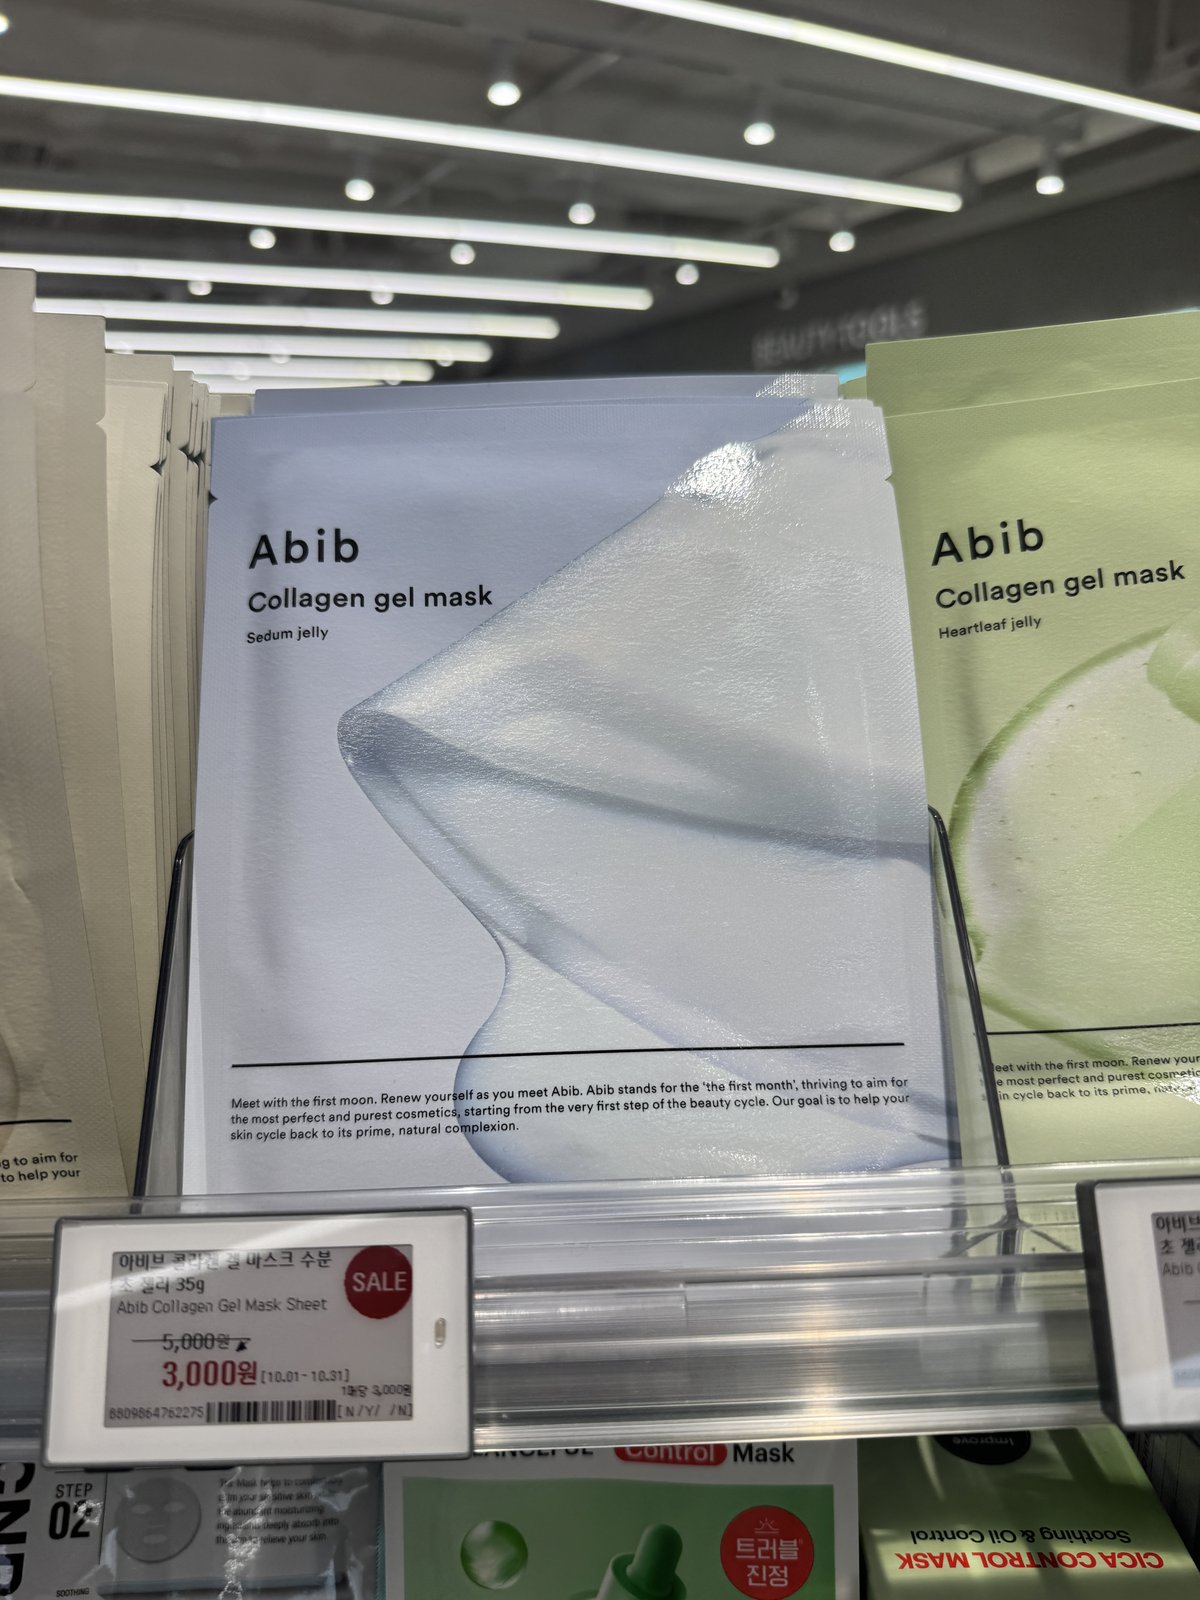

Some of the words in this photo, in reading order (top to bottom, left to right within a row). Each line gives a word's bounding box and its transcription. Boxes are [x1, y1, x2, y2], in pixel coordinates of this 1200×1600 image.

[248, 528, 359, 569] Abib
[931, 518, 1044, 567] Abib
[935, 577, 1055, 609] Collagen
[1063, 567, 1104, 597] gel
[1113, 560, 1186, 587] mask
[248, 587, 365, 613] Collagen
[374, 586, 414, 613] gel
[424, 584, 493, 607] mask
[246, 629, 293, 644] Sedum
[296, 626, 329, 641] jelly
[938, 617, 1008, 639] Heartleaf
[1011, 615, 1042, 632] jelly
[992, 1063, 1014, 1073] eet
[1017, 1061, 1042, 1072] with
[1044, 1060, 1064, 1071] the
[1066, 1059, 1089, 1070] first
[1092, 1059, 1128, 1069] moon.
[1132, 1055, 1171, 1066] Renew
[1006, 1076, 1036, 1087] most
[1038, 1074, 1081, 1088] perfect
[1083, 1073, 1104, 1084] and
[1107, 1071, 1145, 1083] purest
[231, 1098, 260, 1109] Meet
[263, 1096, 288, 1108] with
[291, 1096, 310, 1108] the
[313, 1095, 337, 1107] first
[340, 1096, 377, 1107] moon.
[381, 1092, 421, 1105] Renew
[425, 1089, 474, 1105] yourself
[477, 1091, 490, 1101] as
[493, 1090, 515, 1103] you
[518, 1087, 548, 1099] meet
[551, 1085, 583, 1097] Abib.
[587, 1084, 615, 1097] Abib
[618, 1083, 657, 1096] stands
[660, 1081, 677, 1094] for
[680, 1082, 700, 1093] the
[729, 1080, 752, 1092] first
[802, 1078, 848, 1092] thriving
[851, 1079, 863, 1089] to
[866, 1077, 888, 1089] aim
[891, 1076, 908, 1088] for
[1013, 1089, 1044, 1101] cycle
[1047, 1088, 1075, 1099] back
[1079, 1087, 1090, 1097] to
[1094, 1086, 1108, 1097] its
[1112, 1084, 1150, 1097] prime,
[230, 1114, 249, 1125] the
[252, 1114, 279, 1125] most
[282, 1111, 326, 1126] perfect
[329, 1111, 350, 1122] and
[354, 1110, 392, 1123] purest
[396, 1106, 461, 1120] cosmetics,
[464, 1104, 510, 1118] starting
[514, 1103, 542, 1115] from
[545, 1102, 565, 1113] the
[568, 1102, 593, 1115] very
[597, 1100, 620, 1112] first
[623, 1100, 649, 1112] step
[652, 1098, 666, 1110] of
[667, 1098, 687, 1109] the
[690, 1096, 731, 1110] beauty
[734, 1096, 769, 1110] cycle.
[772, 1095, 795, 1107] Our
[798, 1094, 823, 1108] goal
[826, 1094, 835, 1105] is
[839, 1094, 850, 1105] to
[854, 1093, 880, 1106] help
[883, 1094, 909, 1106] your
[230, 1129, 253, 1140] skin
[256, 1128, 286, 1142] cycle
[290, 1128, 318, 1139] back
[323, 1128, 334, 1138] to
[338, 1126, 352, 1138] its
[356, 1126, 394, 1139] prime,
[399, 1123, 441, 1136] natural
[445, 1121, 519, 1134] complexion.
[13, 1157, 28, 1166] to
[32, 1153, 57, 1164] aim
[60, 1151, 79, 1162] for
[1, 1173, 15, 1183] to
[18, 1169, 48, 1181] help
[52, 1169, 81, 1180] your
[1161, 1239, 1175, 1255] 초
[119, 1251, 165, 1272] 아비브
[247, 1250, 294, 1269] 마스크
[300, 1250, 331, 1269] 수분
[1163, 1262, 1194, 1276] Abib
[175, 1277, 205, 1295] 35g
[352, 1271, 408, 1293] SALE
[116, 1299, 149, 1315] Abib
[152, 1298, 214, 1315] Collagen
[220, 1298, 241, 1313] Gel
[246, 1298, 282, 1312] Mask
[286, 1297, 328, 1312] Sheet
[162, 1332, 230, 1354] 5,000원
[162, 1359, 258, 1391] 3,000원
[109, 1406, 204, 1420] 8809864762275
[952, 1435, 1015, 1447] Improve
[625, 1444, 714, 1462] Control
[732, 1443, 795, 1463] Mask
[55, 1483, 93, 1499] STEP
[48, 1500, 92, 1540] 02
[910, 1529, 985, 1545] Control
[991, 1529, 1017, 1544] Oil
[1020, 1529, 1036, 1544] &
[1039, 1526, 1132, 1544] Soothing
[735, 1537, 799, 1560] 트러블
[894, 1551, 970, 1570] MASK
[972, 1551, 1097, 1569] CONTROL
[1098, 1551, 1165, 1569] CICA
[746, 1564, 789, 1588] 진정
